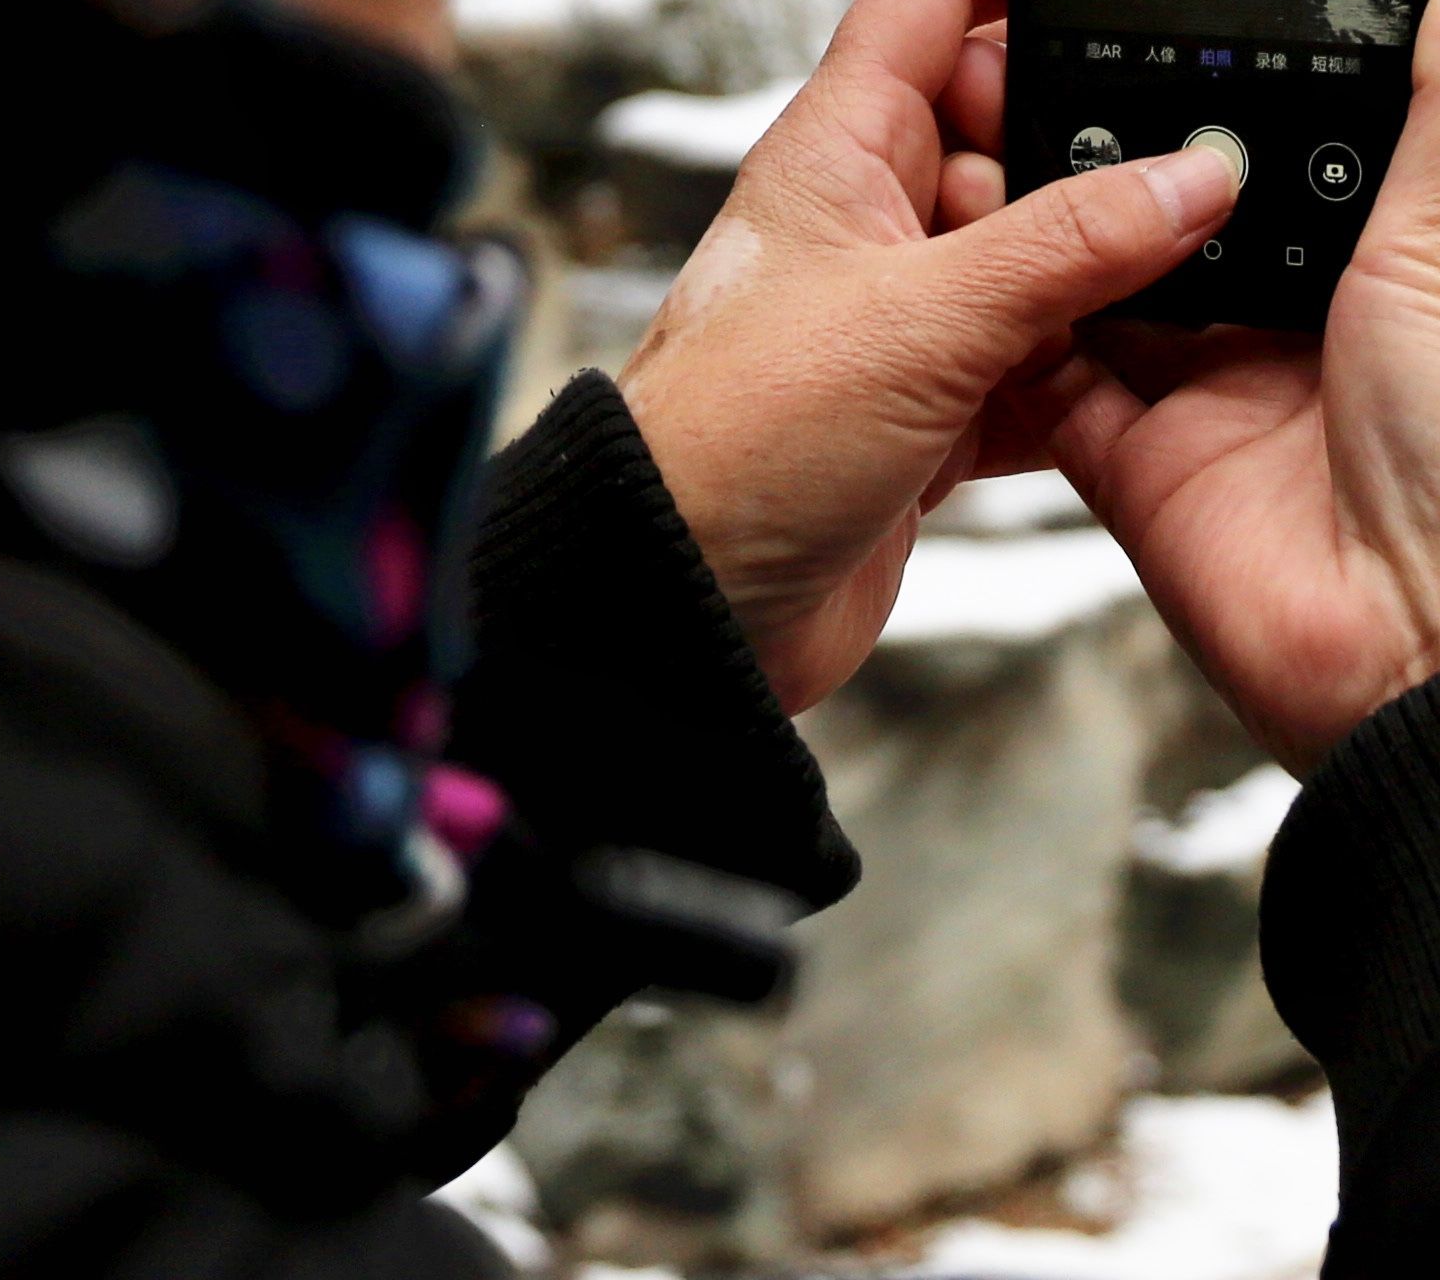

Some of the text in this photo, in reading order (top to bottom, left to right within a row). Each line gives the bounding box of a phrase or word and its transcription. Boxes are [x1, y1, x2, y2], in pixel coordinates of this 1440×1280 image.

[1145, 45, 1176, 63] 人像
[1200, 48, 1232, 67] 拍照
[1256, 52, 1288, 70] 录像
[1311, 55, 1361, 74] 短视频
